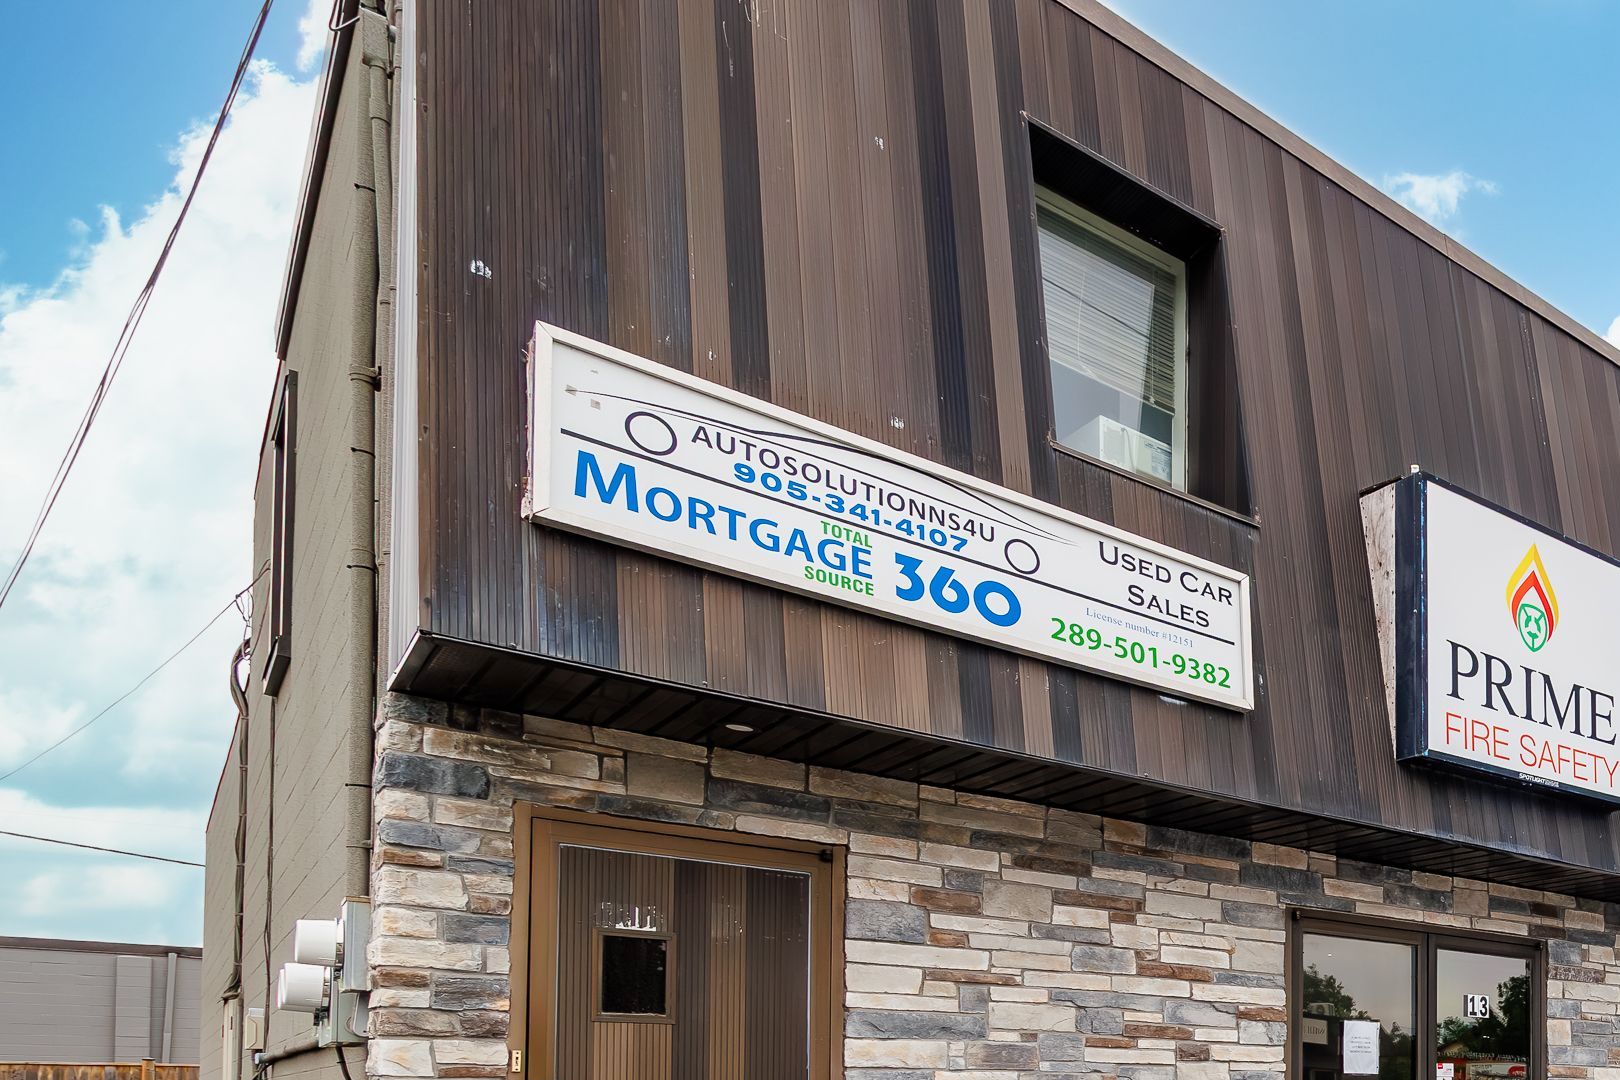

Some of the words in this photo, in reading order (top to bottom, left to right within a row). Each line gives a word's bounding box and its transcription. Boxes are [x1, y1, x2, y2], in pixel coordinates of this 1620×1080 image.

[691, 425, 995, 542] AUTOSOLUTIONNS4U
[733, 463, 968, 552] 905-341-4107
[574, 449, 873, 580] MORTGAGE
[895, 552, 1022, 627] 360
[820, 520, 873, 548] TOTAL
[804, 565, 875, 597] SOURCE
[1098, 540, 1172, 584] USED
[1179, 571, 1233, 606] CAR
[1127, 585, 1210, 628] SALES
[1050, 617, 1231, 689] 289-501-9382
[1085, 607, 1123, 626] License
[1125, 622, 1160, 638] number
[1162, 632, 1194, 648] #12151
[1446, 639, 1617, 746] PRIME
[1445, 711, 1510, 761] FIRE
[1519, 734, 1619, 788] SAFETY
[1469, 995, 1488, 1017] 13
